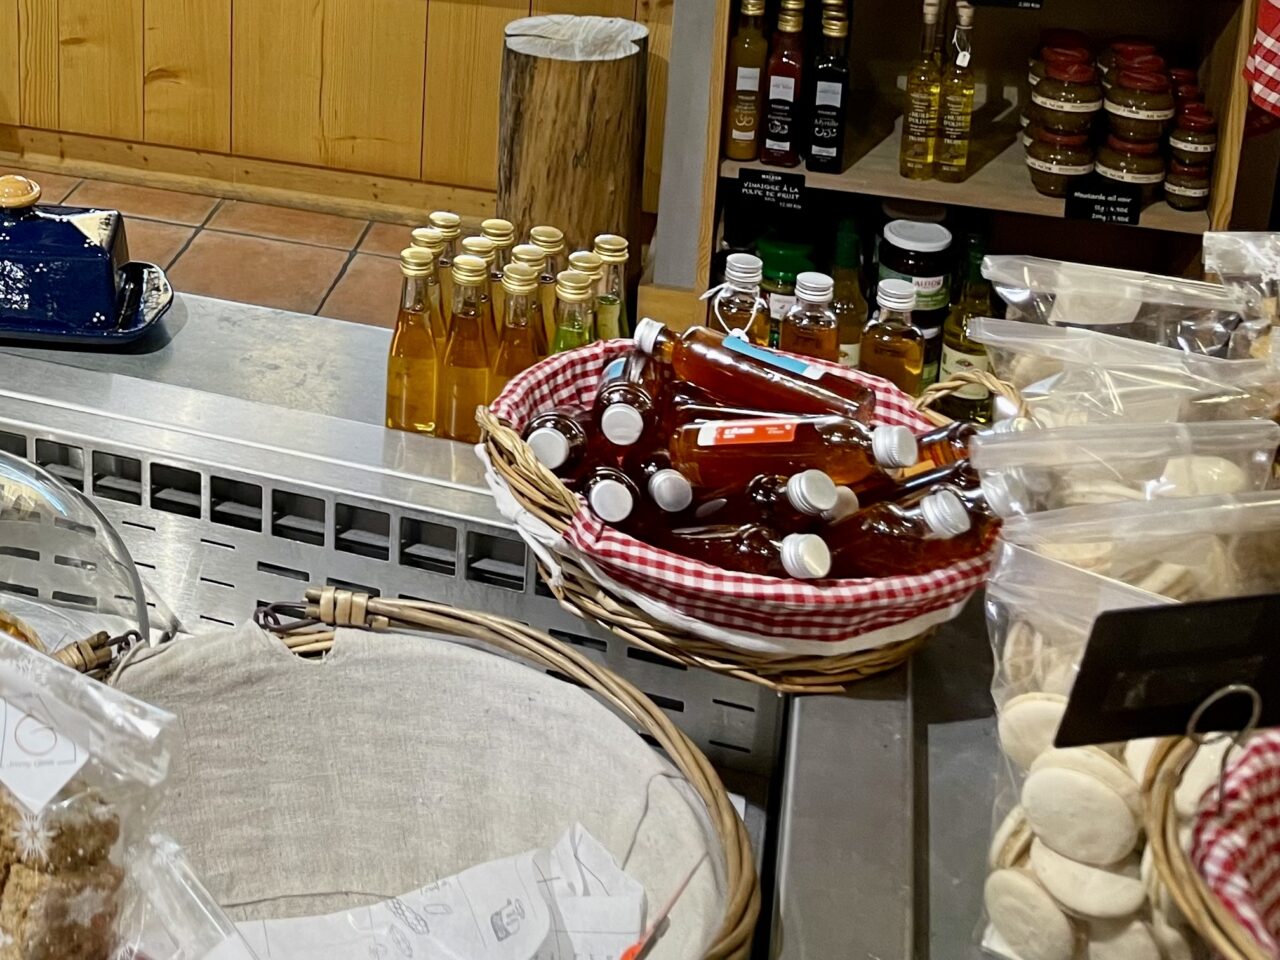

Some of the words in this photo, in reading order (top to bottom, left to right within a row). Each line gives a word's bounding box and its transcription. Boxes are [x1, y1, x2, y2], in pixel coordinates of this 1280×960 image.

[743, 181, 780, 191] VINAIGRE
[741, 188, 763, 196] PULPE
[777, 192, 800, 200] FRUIT
